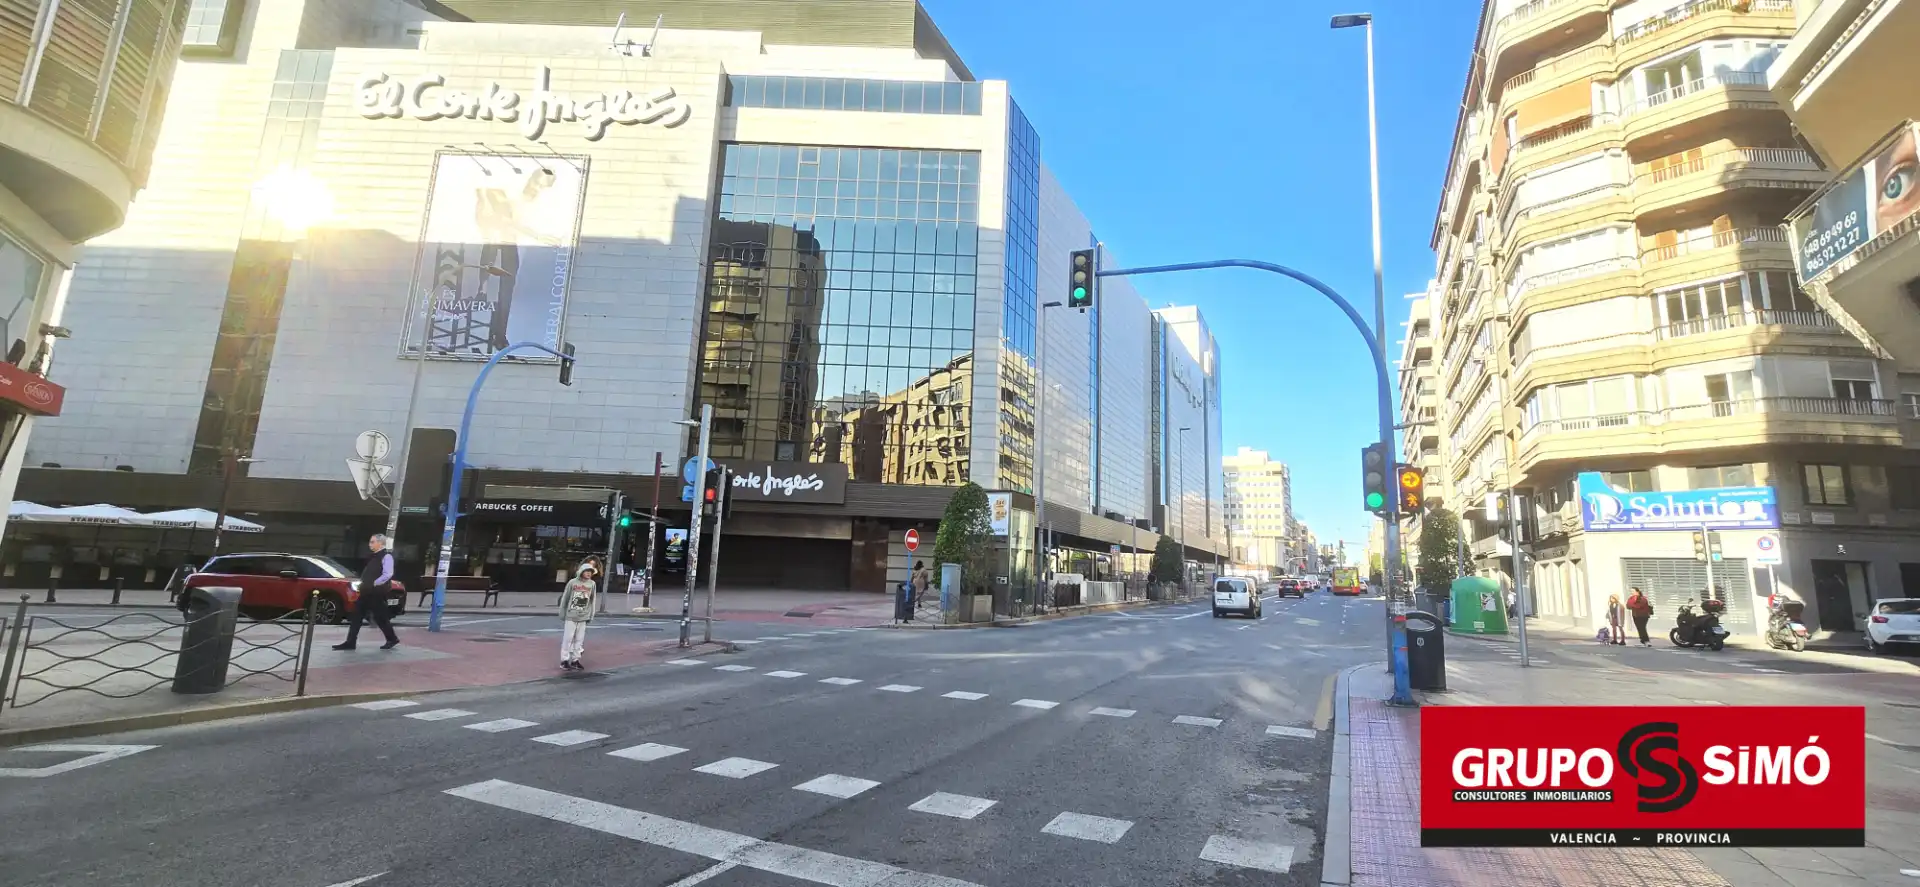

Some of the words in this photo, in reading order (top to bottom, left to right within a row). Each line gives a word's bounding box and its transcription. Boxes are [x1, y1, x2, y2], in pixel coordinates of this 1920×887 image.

[353, 72, 404, 119] El
[412, 74, 520, 122] Corte
[517, 65, 692, 142] Inglés
[1804, 239, 1820, 257] 648
[1820, 230, 1831, 246] 69
[1831, 221, 1843, 236] 49
[1844, 211, 1857, 228] 69
[1806, 254, 1824, 272] 965
[1822, 246, 1835, 261] 92
[1834, 237, 1848, 252] 12
[1846, 227, 1860, 245] 27
[762, 465, 824, 496] Inglés
[475, 503, 517, 511] ARBUCKS
[520, 504, 553, 512] COFFEE
